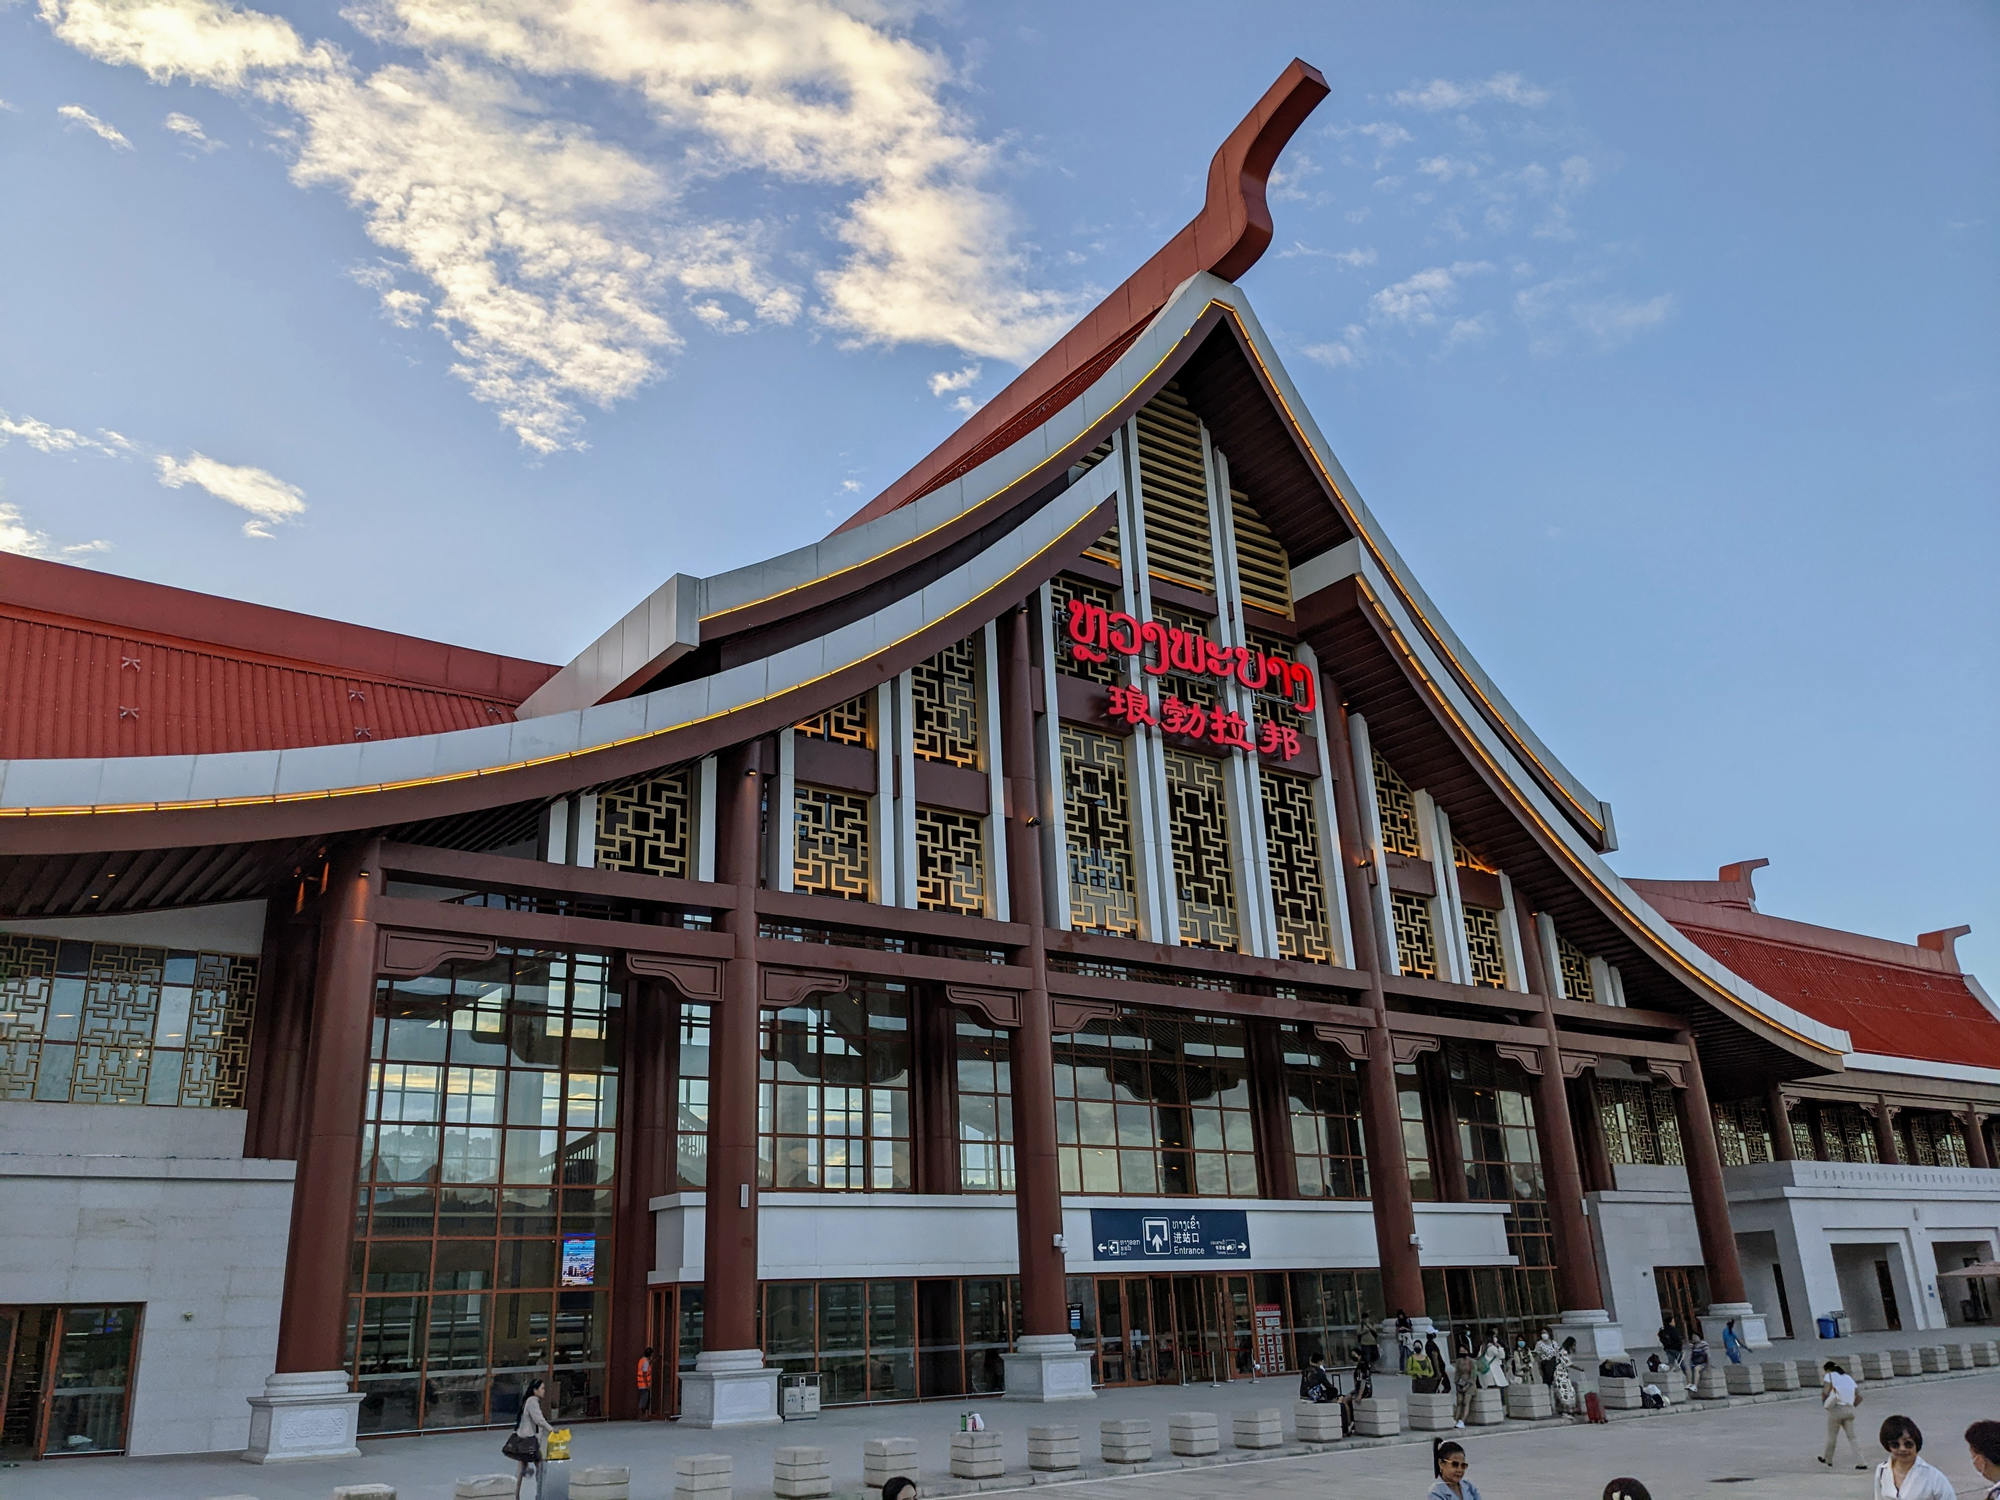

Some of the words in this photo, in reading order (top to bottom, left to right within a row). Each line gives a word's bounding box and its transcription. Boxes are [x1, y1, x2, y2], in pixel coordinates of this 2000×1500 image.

[1067, 600, 1316, 714] ຫຼວງພະບາງ
[1106, 685, 1300, 761] 琅勃拉邦
[1173, 1232, 1200, 1243] 进站口
[1173, 1246, 1205, 1255] Entrance
